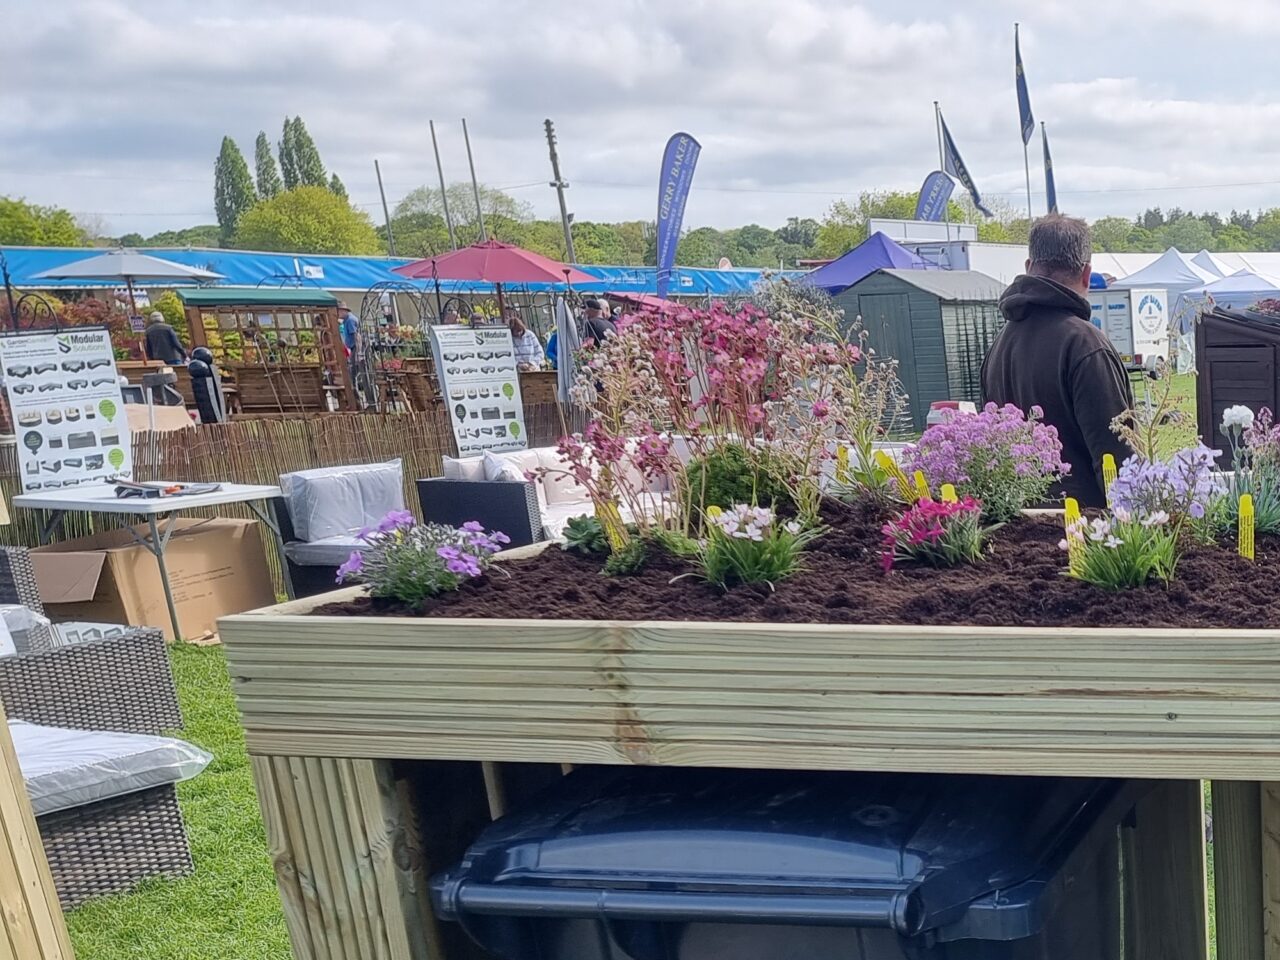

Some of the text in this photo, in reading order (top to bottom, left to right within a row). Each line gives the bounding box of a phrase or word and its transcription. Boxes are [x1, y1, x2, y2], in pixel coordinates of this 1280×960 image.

[660, 180, 677, 220] GERRY
[671, 136, 689, 176] BAKER
[70, 334, 104, 344] Modular
[71, 344, 106, 353] Solutions
